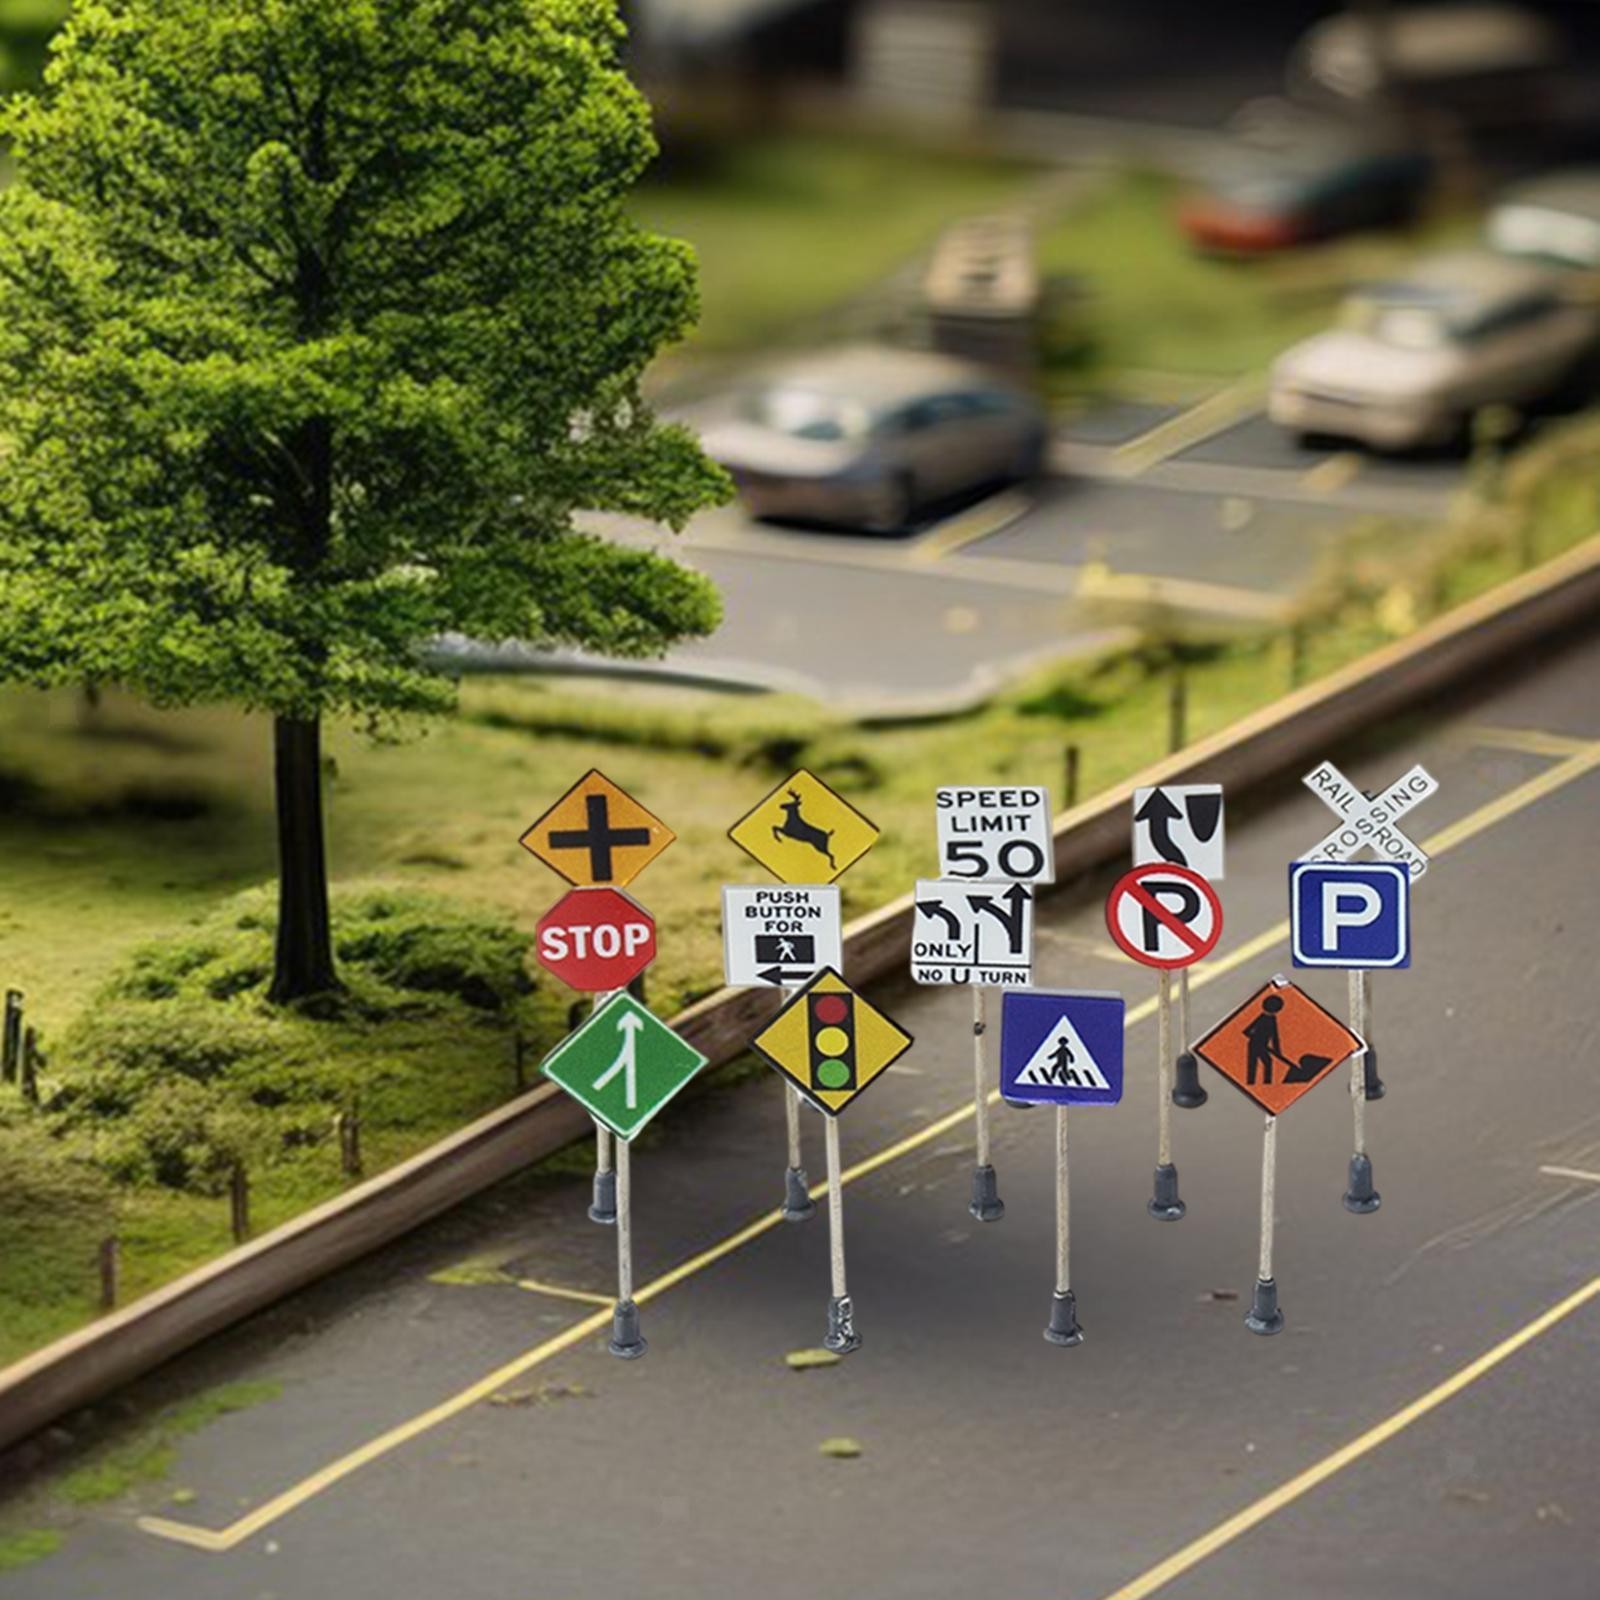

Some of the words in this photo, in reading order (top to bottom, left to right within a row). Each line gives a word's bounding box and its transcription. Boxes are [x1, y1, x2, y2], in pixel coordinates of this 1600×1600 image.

[937, 790, 1040, 808] SPEED
[951, 815, 1031, 832] LIMIT
[1311, 768, 1355, 814] RAIL
[1371, 826, 1425, 876] ROAD
[946, 839, 1044, 878] 50
[756, 891, 809, 903] PUSH
[745, 906, 821, 918] BUTTON
[1141, 881, 1200, 952] P
[1322, 881, 1382, 951] P
[764, 920, 803, 933] FOR
[541, 923, 650, 960] STOP
[914, 942, 971, 958] ONLY
[918, 968, 943, 981] NO
[951, 968, 970, 984] U
[979, 970, 1026, 983] TURN
